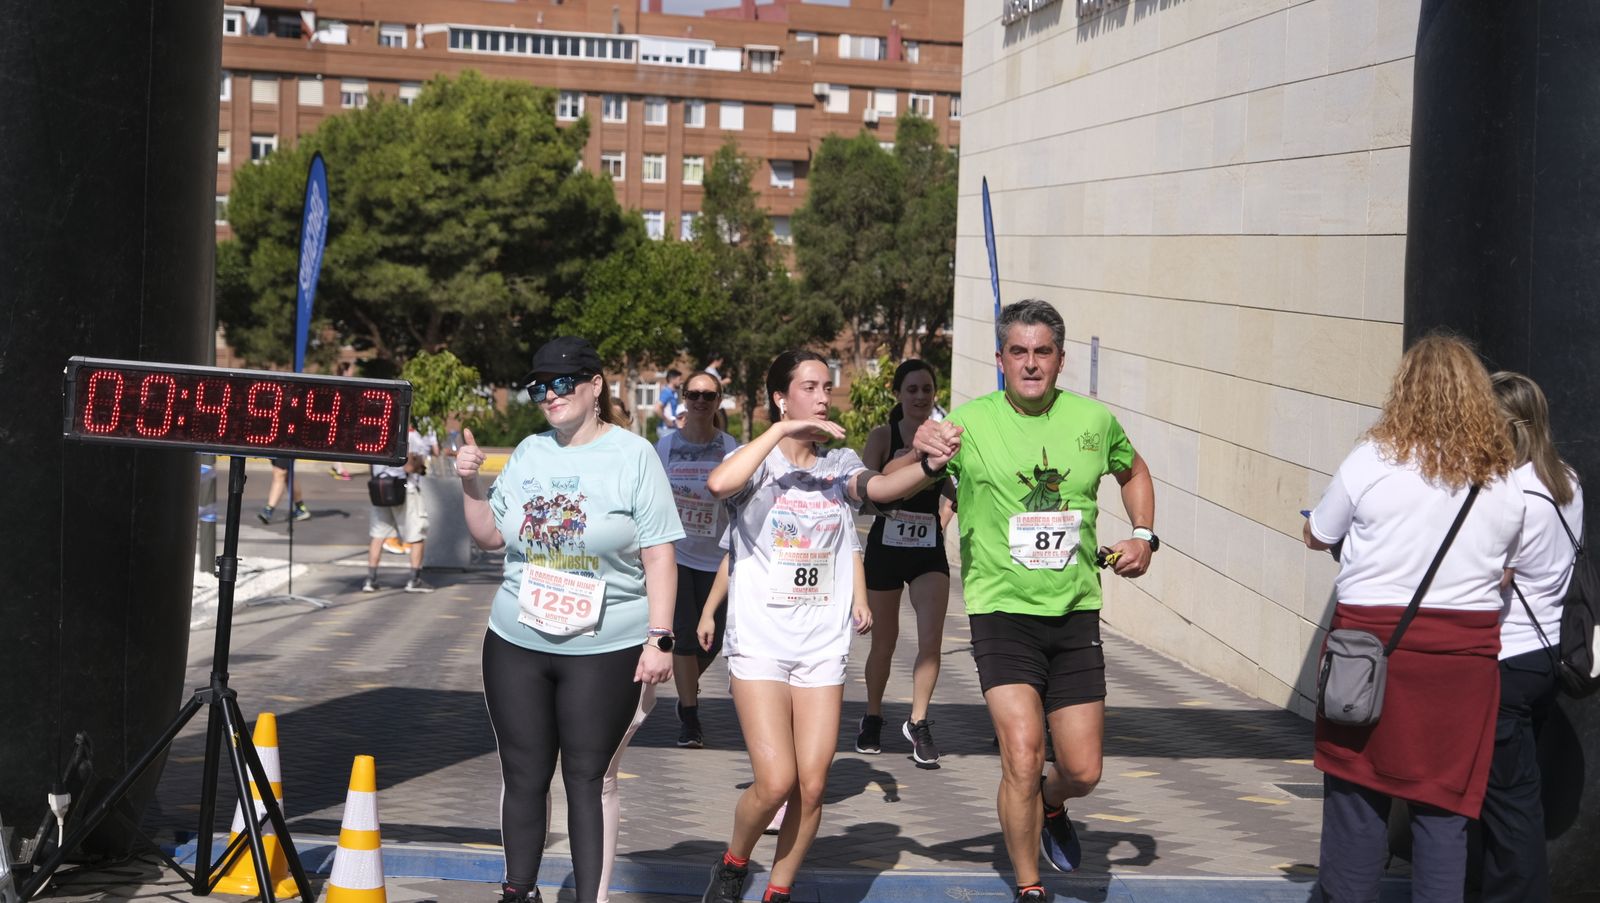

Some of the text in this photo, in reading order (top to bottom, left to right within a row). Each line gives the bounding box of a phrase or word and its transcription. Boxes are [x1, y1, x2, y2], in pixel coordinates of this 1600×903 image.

[83, 370, 393, 454] 00:49:43
[896, 523, 928, 538] 110
[1035, 531, 1066, 551] 87
[526, 547, 599, 571] San Silvestre
[794, 567, 818, 586] 88
[531, 588, 592, 618] 1259
